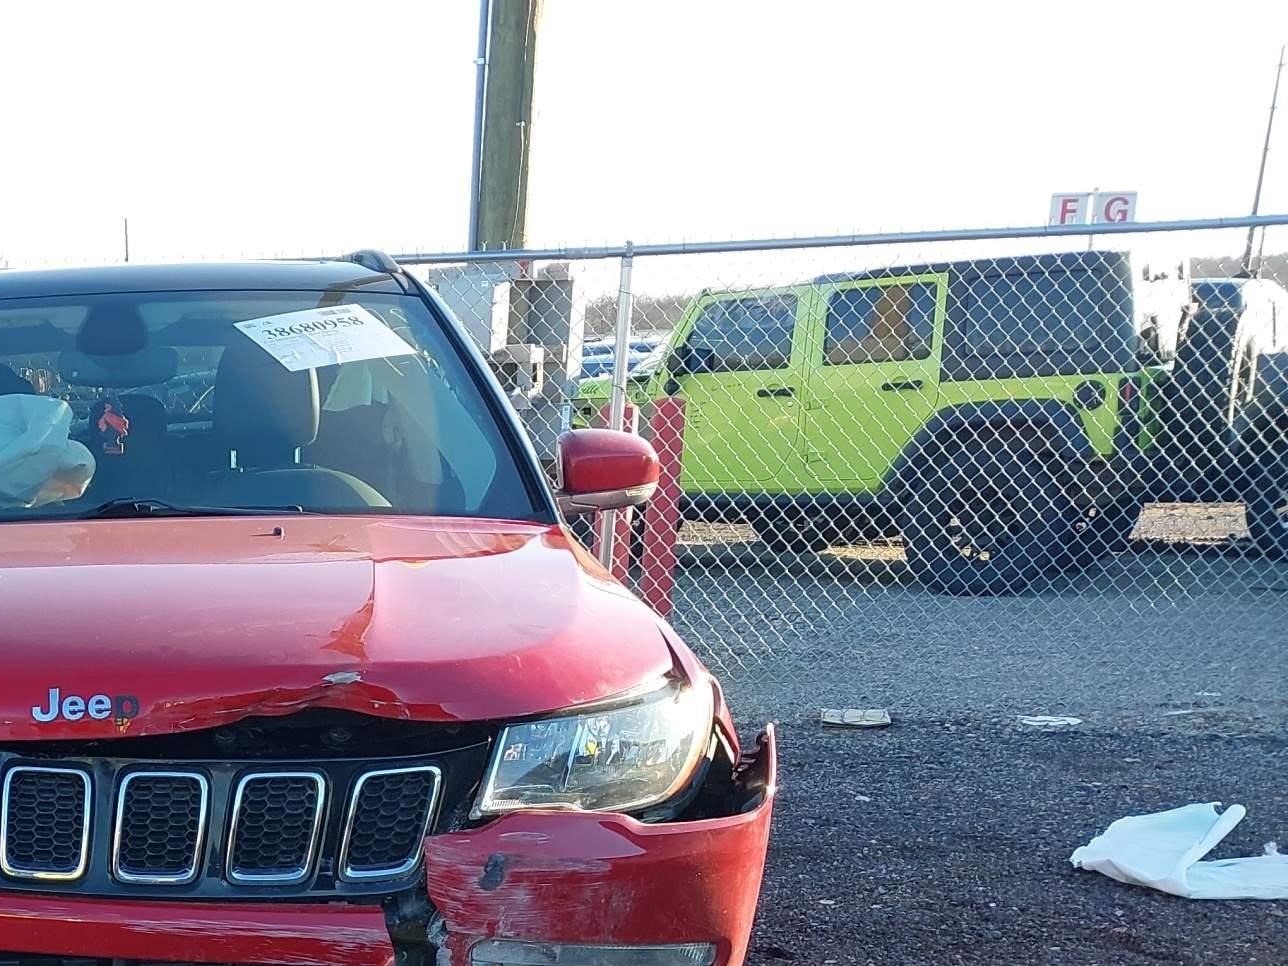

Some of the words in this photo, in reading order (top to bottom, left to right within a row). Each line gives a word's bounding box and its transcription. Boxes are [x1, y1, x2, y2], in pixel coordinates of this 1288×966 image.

[1060, 198, 1079, 225] F
[1104, 197, 1129, 223] G
[262, 316, 364, 340] 38680958
[31, 687, 140, 725] Jeep
